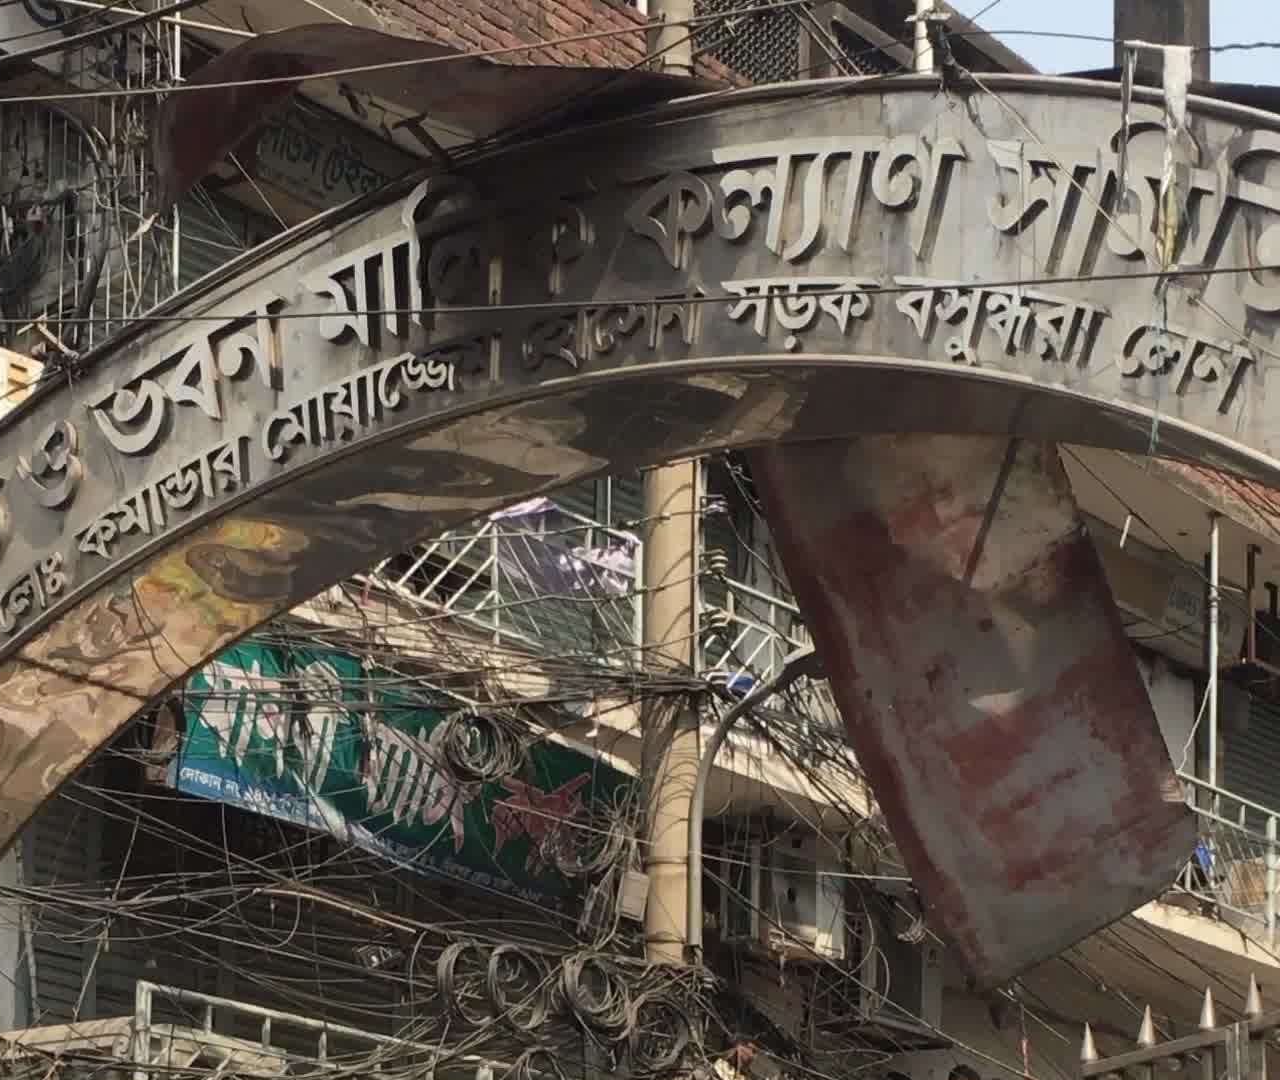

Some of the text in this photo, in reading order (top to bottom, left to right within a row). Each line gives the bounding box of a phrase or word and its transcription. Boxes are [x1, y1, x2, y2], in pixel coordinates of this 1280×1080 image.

[18, 418, 86, 507] ও
[86, 296, 286, 455] ভবন
[624, 134, 972, 271] কল্যাণ
[73, 436, 252, 560] কমান্ডার
[720, 276, 882, 353] সড়ক
[892, 275, 1113, 367] বসুন্ধরা
[1120, 323, 1256, 415] লেন
